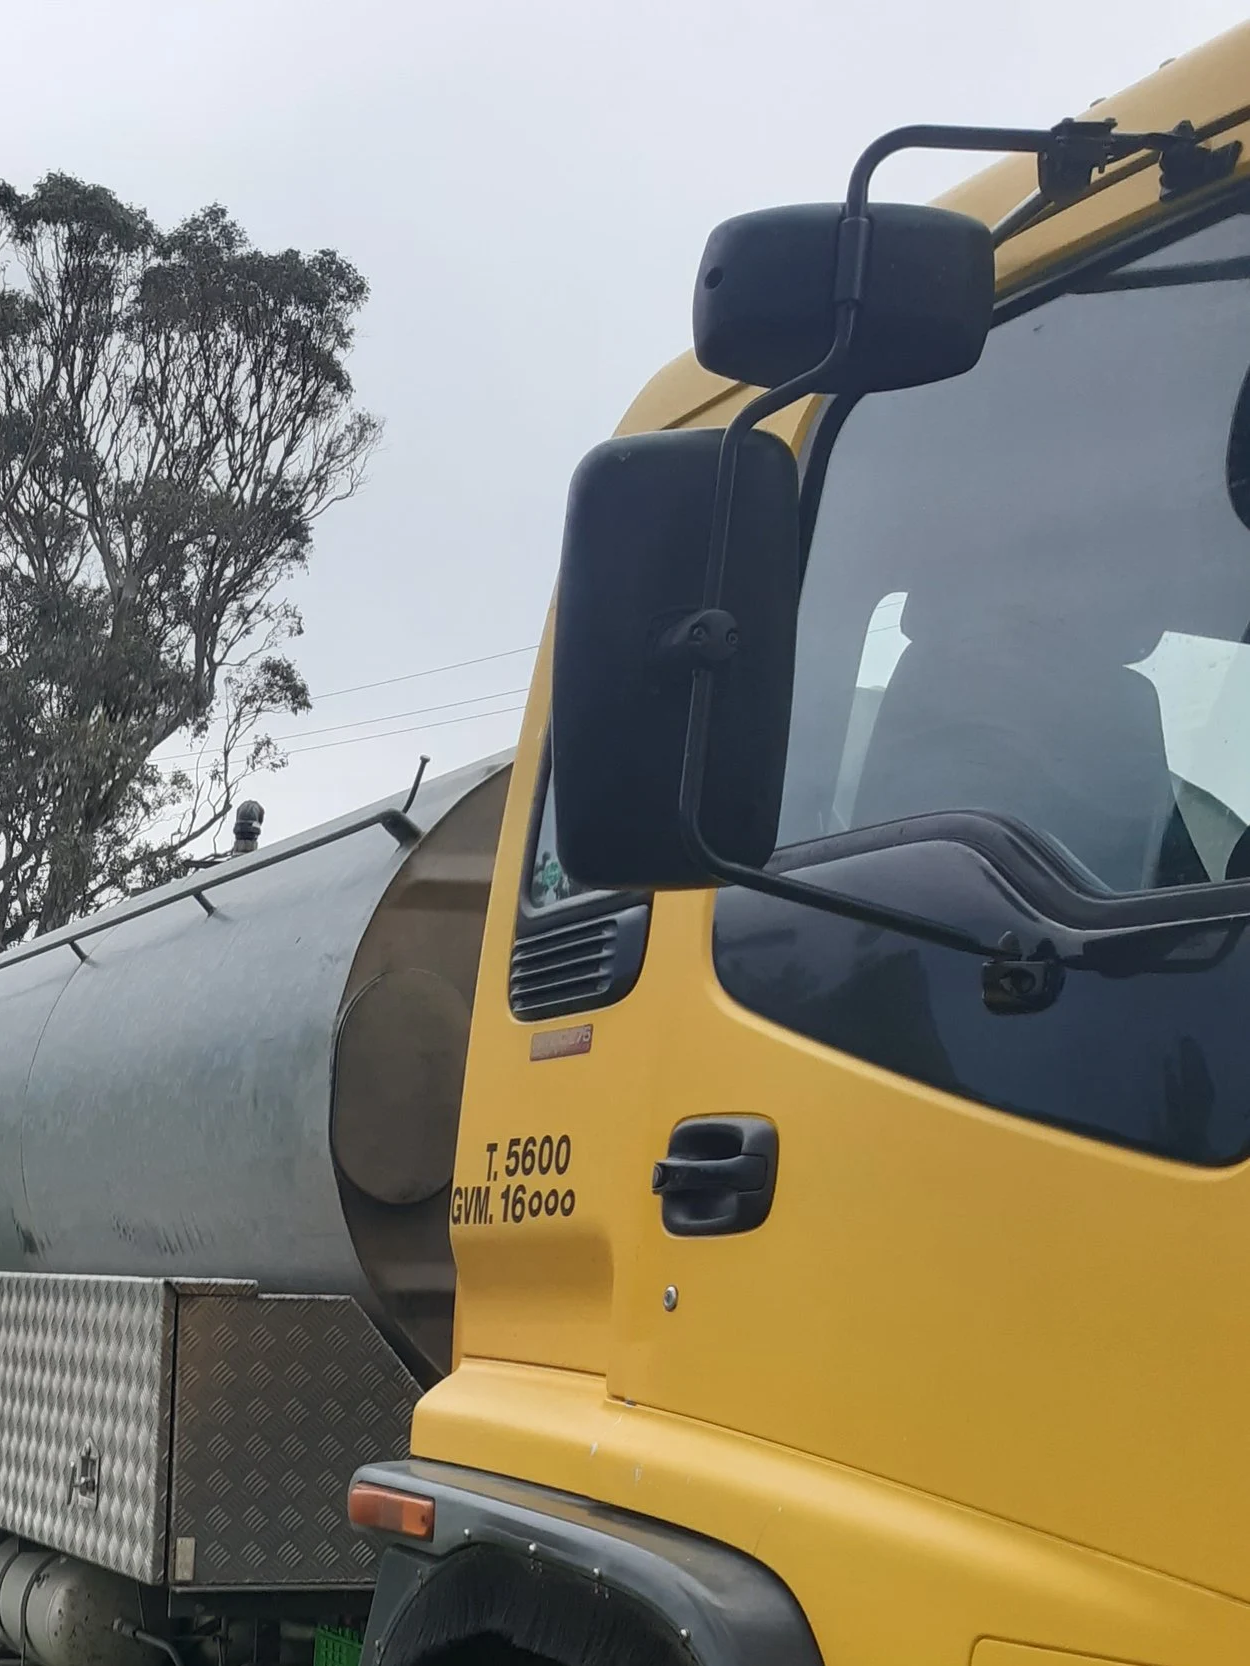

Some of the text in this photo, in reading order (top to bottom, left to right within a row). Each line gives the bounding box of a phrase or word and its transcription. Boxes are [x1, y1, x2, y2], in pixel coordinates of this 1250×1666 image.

[486, 1134, 571, 1182] T. 5600
[451, 1186, 493, 1225] GVM.
